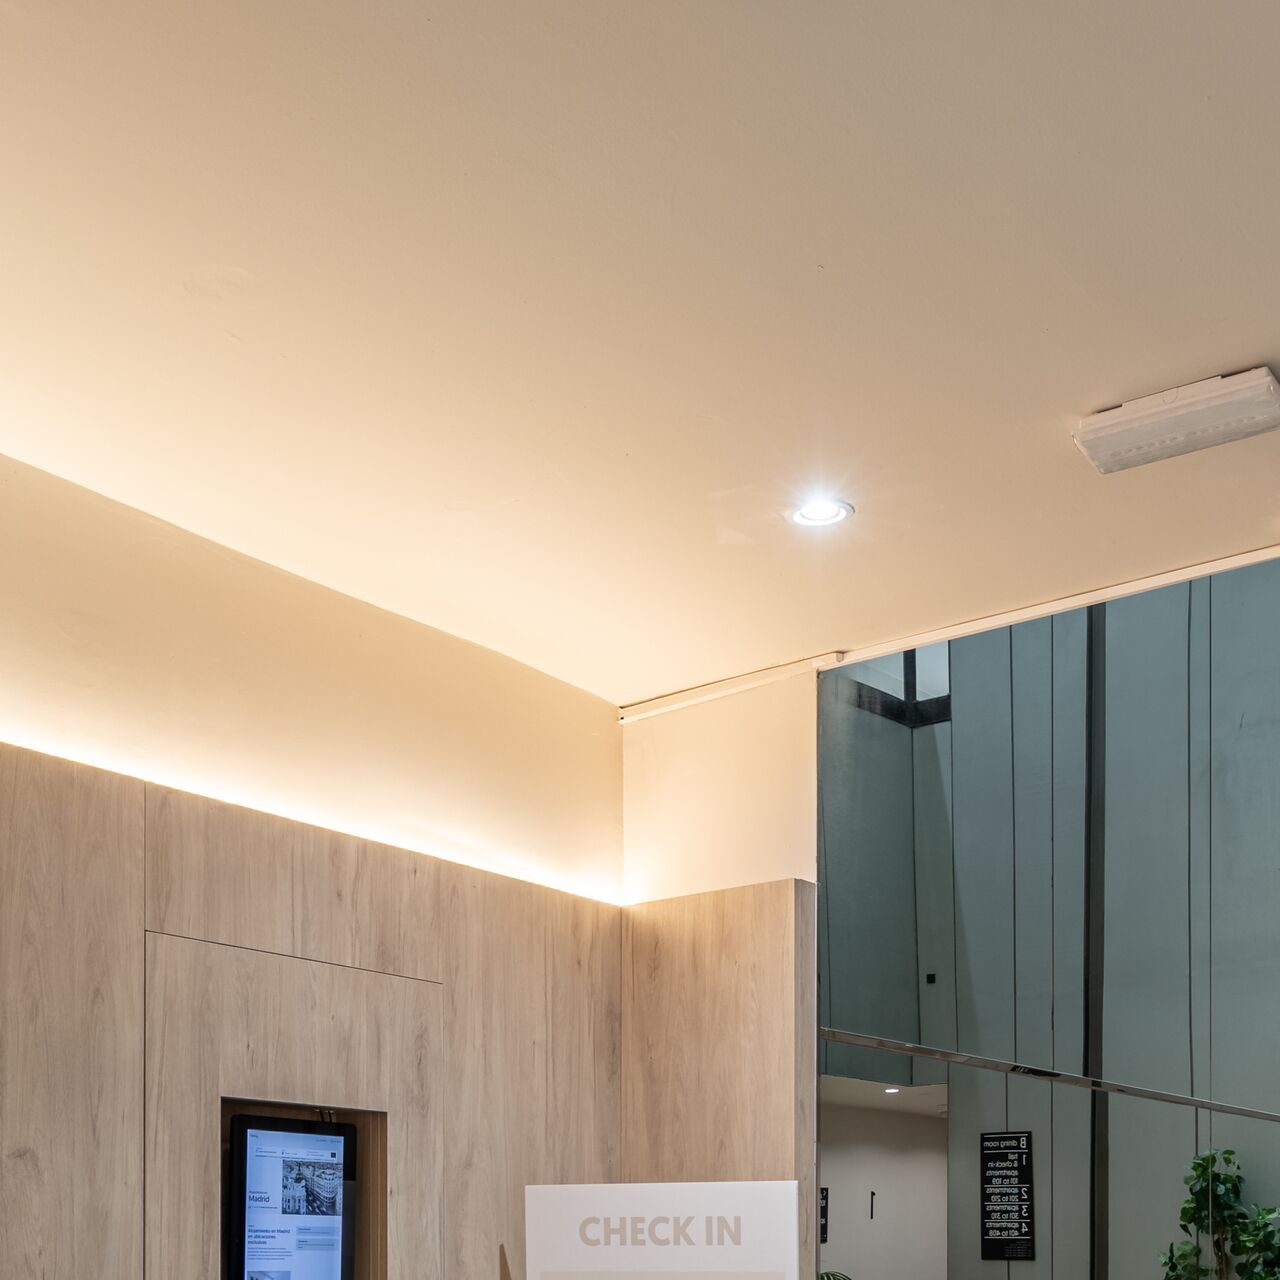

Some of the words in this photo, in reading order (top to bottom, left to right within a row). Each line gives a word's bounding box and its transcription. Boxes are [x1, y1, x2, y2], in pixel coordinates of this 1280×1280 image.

[248, 1195, 270, 1203] Madrid
[579, 1216, 696, 1247] CHECK
[705, 1215, 742, 1246] IN
